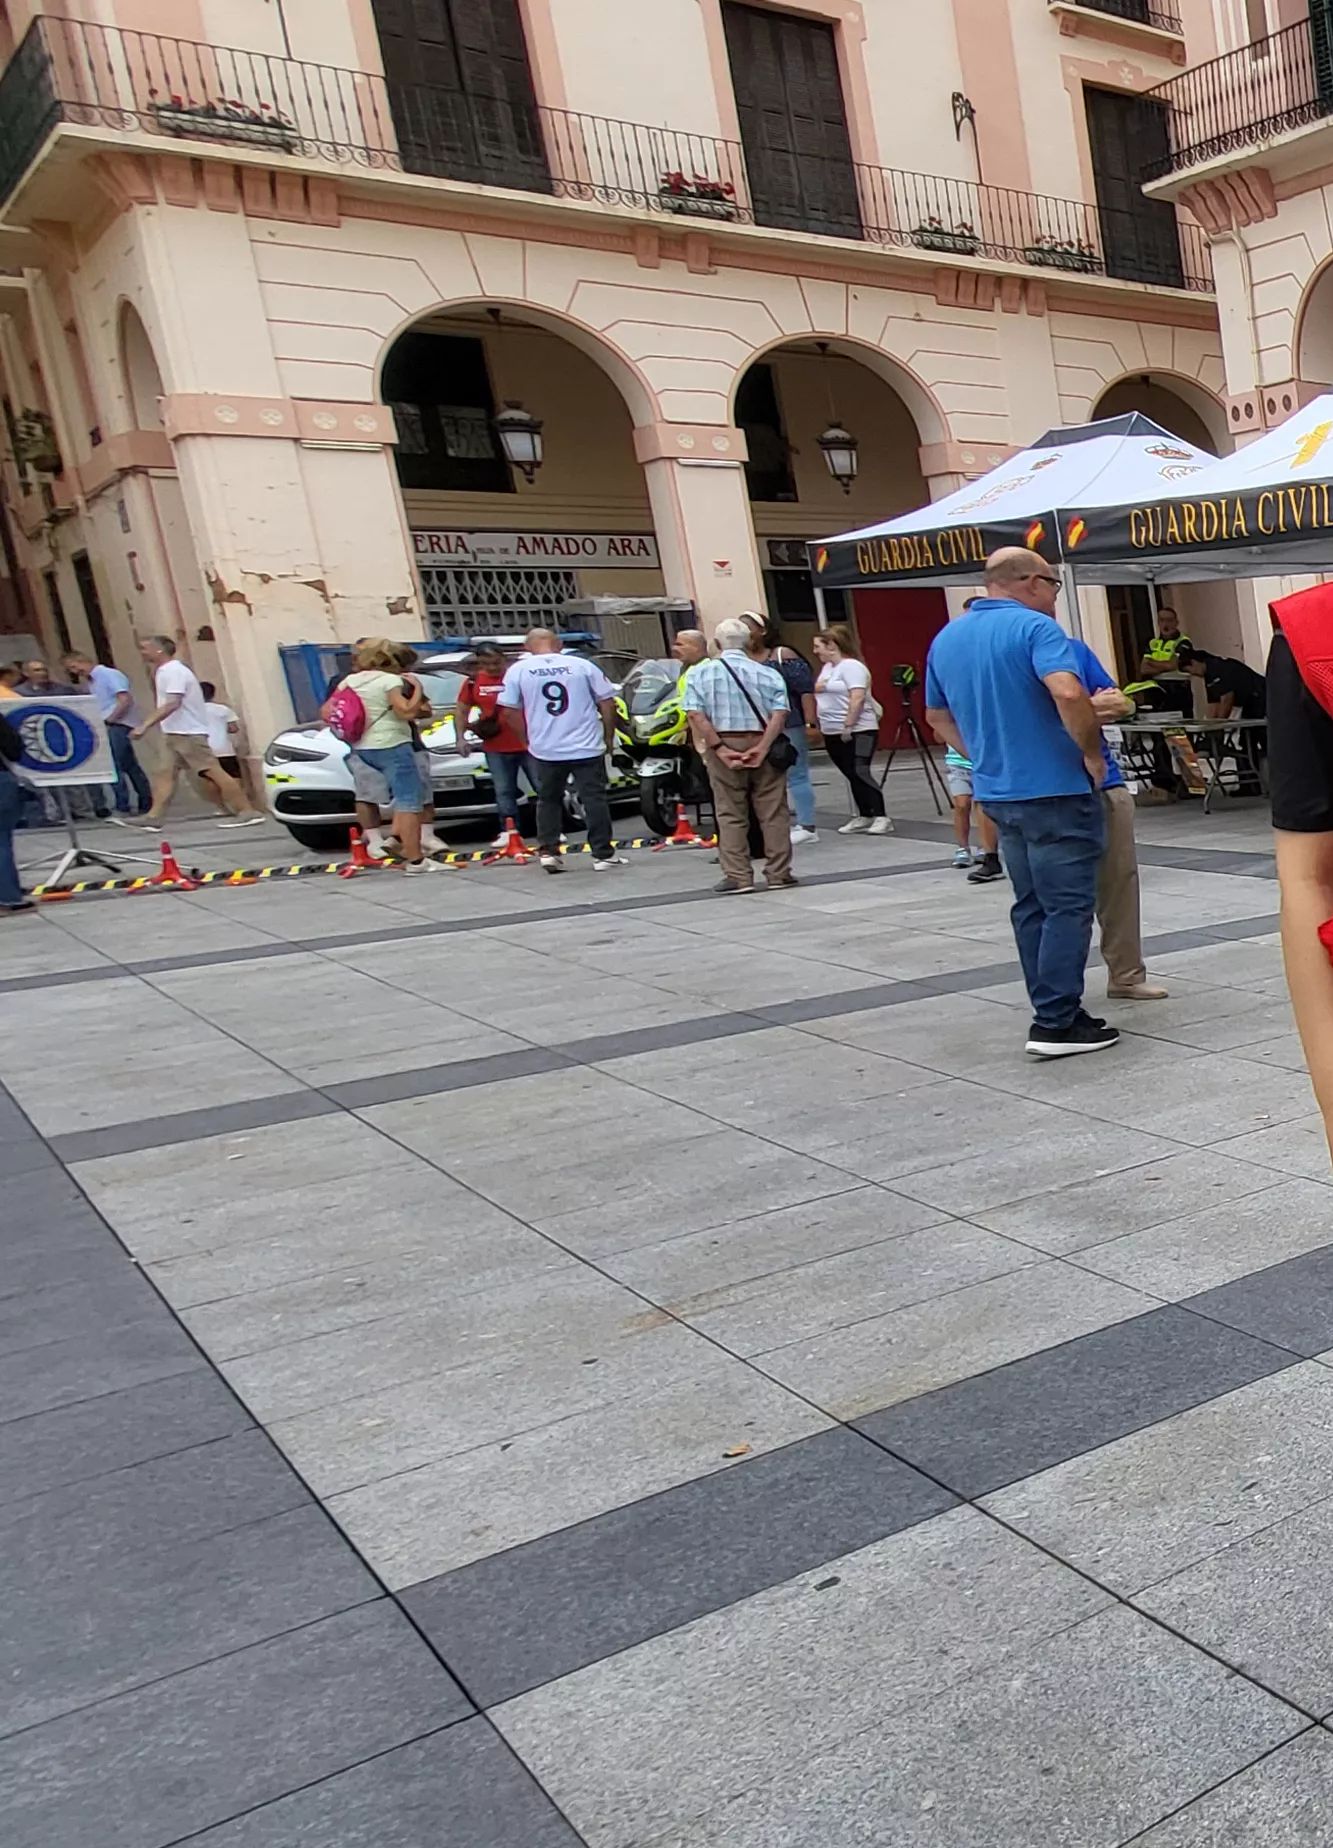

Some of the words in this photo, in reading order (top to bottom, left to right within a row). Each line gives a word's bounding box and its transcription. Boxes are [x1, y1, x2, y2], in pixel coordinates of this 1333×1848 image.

[1129, 496, 1250, 549] GUARDIA
[516, 536, 597, 556] AMADO
[607, 538, 651, 557] ARA
[857, 535, 935, 574] GUARDIA
[937, 527, 989, 566] CIVIL
[541, 680, 569, 717] 9
